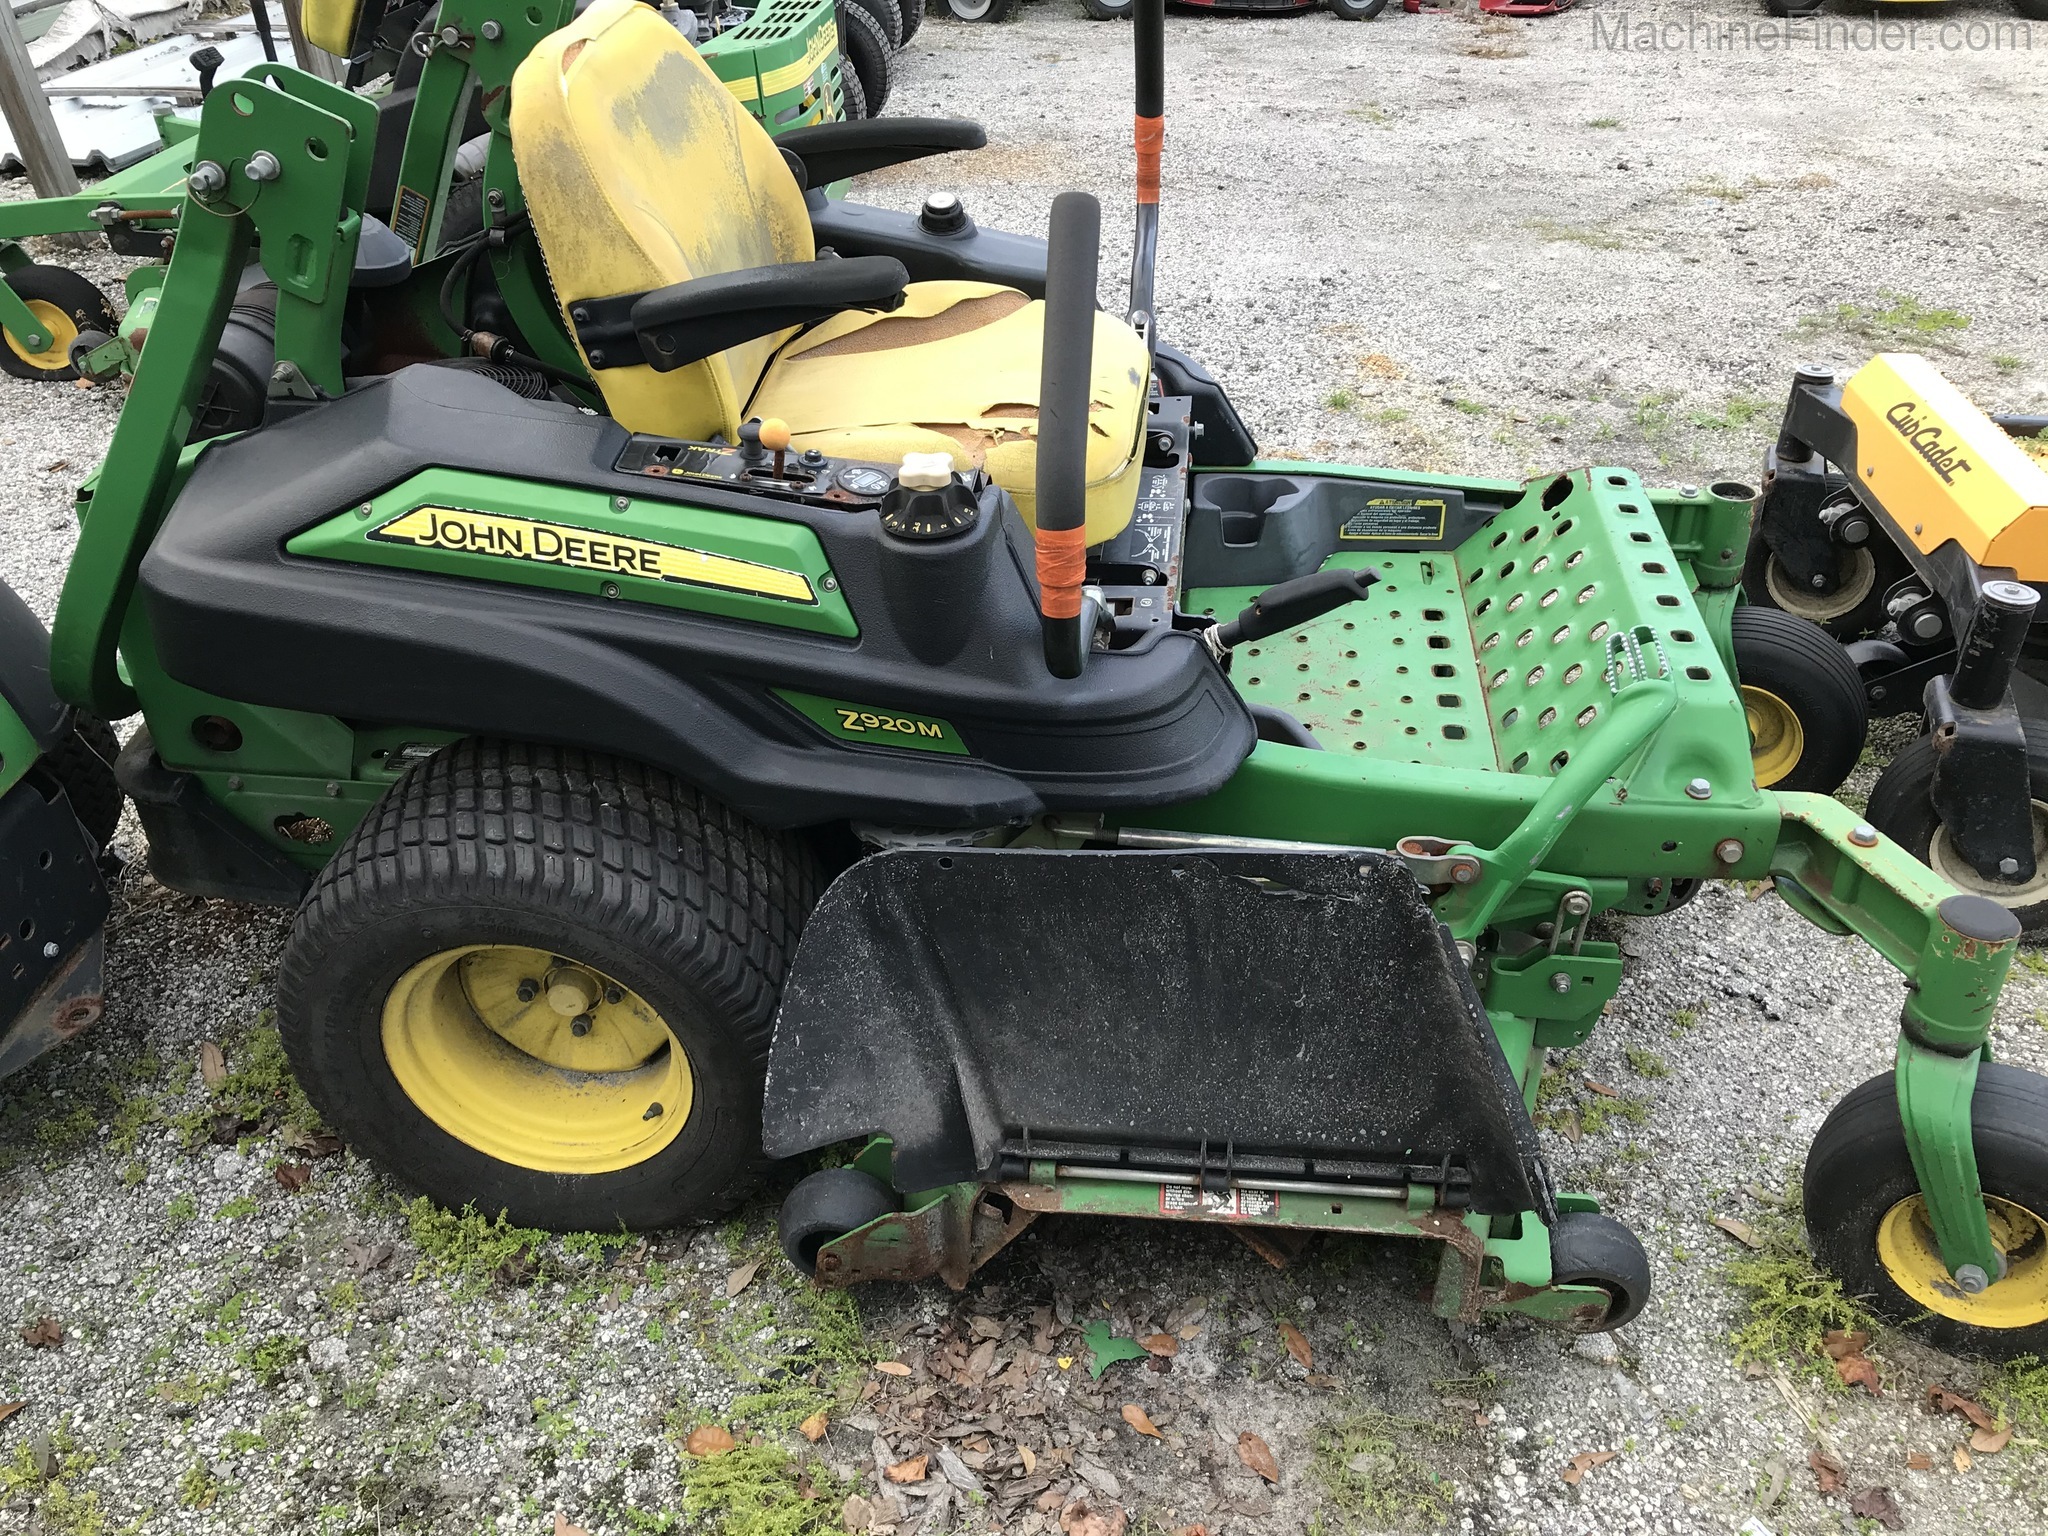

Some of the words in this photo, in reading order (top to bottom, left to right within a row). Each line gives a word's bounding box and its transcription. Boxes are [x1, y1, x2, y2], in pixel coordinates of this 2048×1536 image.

[1886, 402, 1921, 437] Cub
[1909, 427, 1972, 484] Cadet
[418, 513, 523, 552] JOHN
[533, 526, 662, 575] DEERE
[836, 709, 943, 738] Z920M
